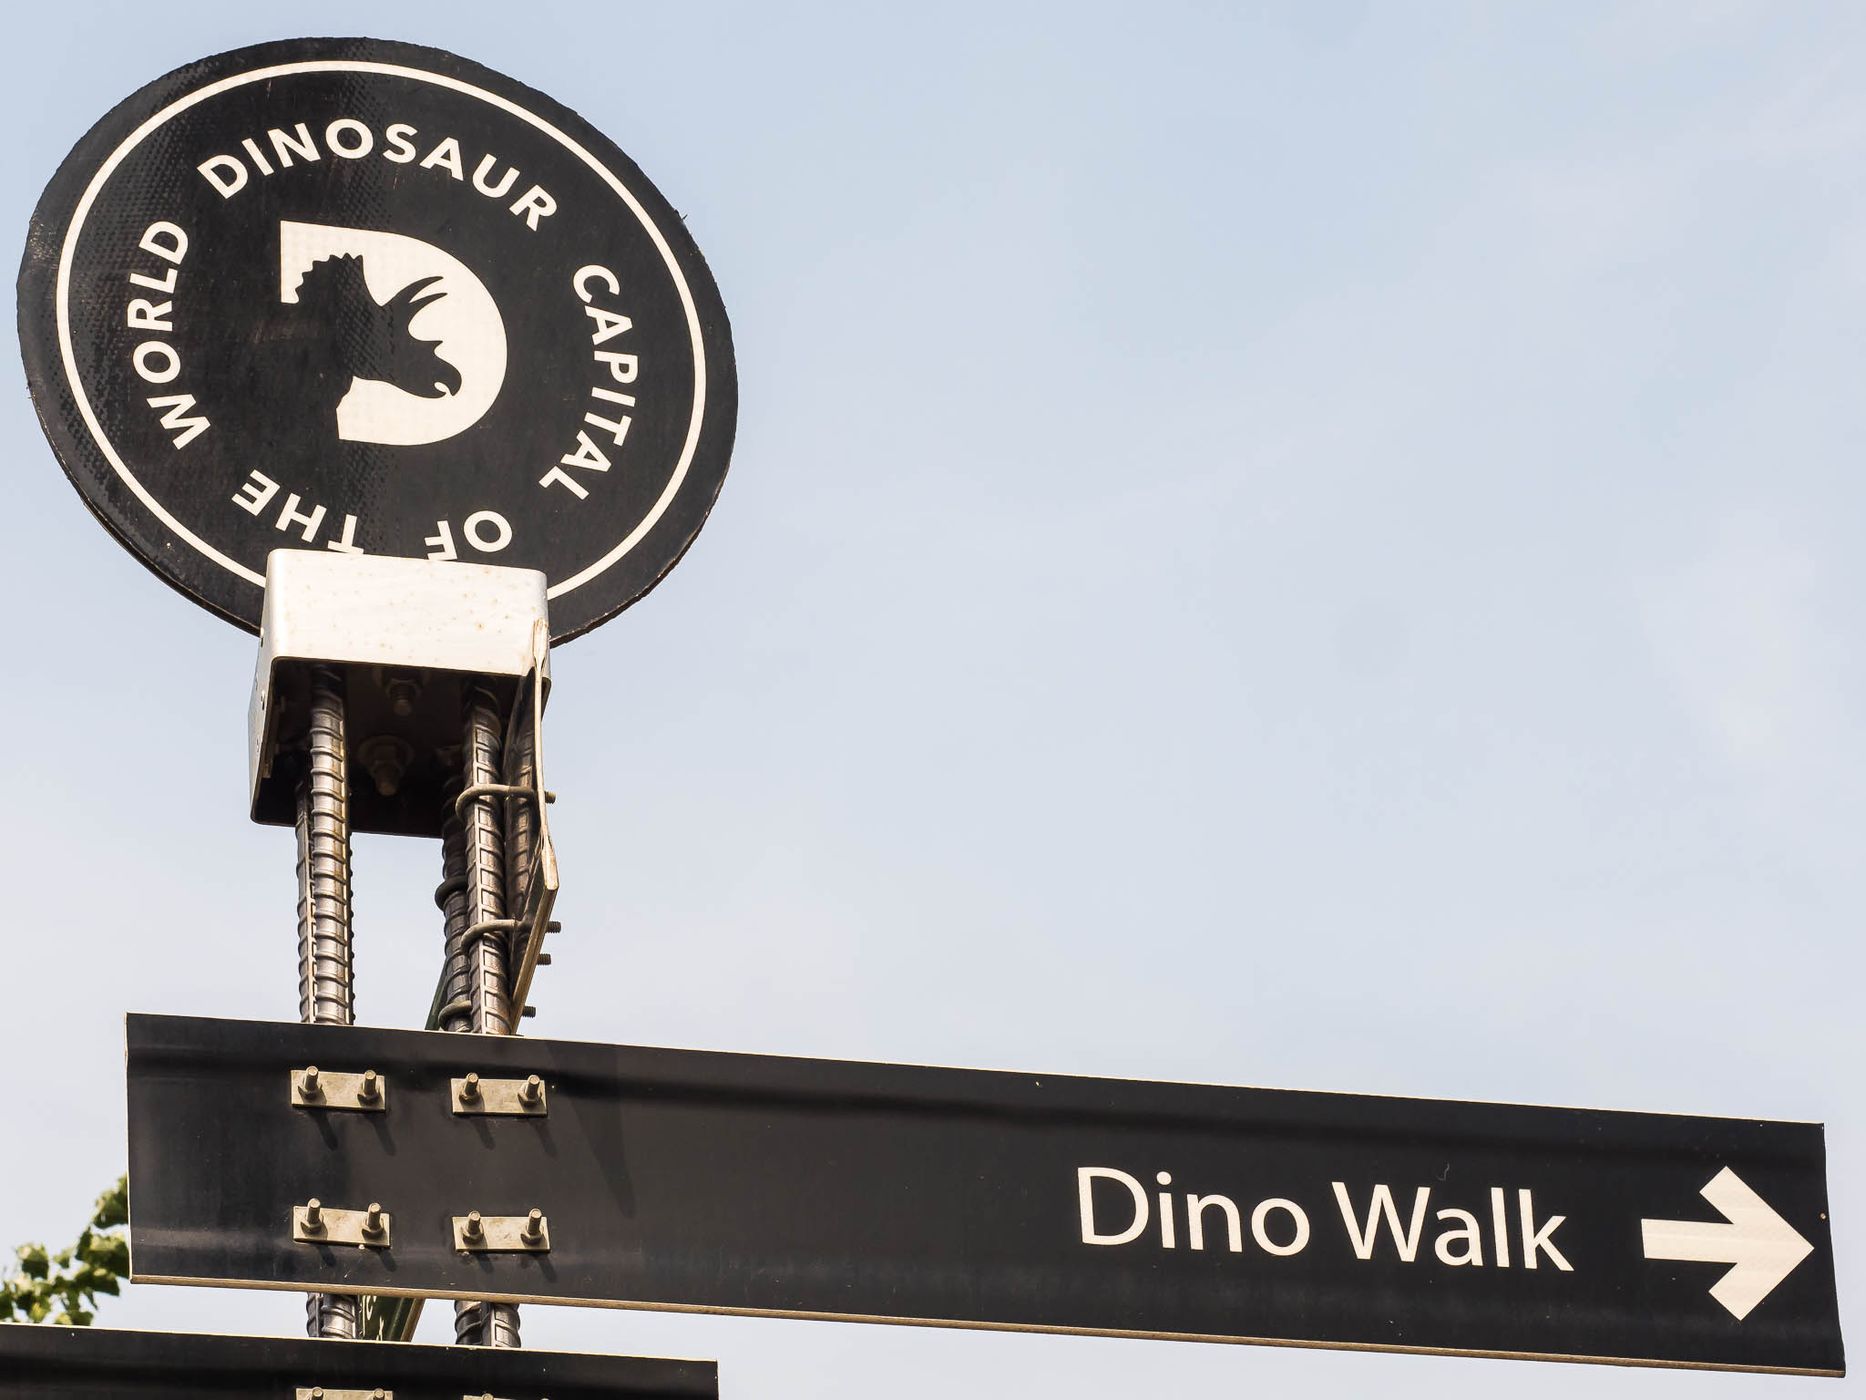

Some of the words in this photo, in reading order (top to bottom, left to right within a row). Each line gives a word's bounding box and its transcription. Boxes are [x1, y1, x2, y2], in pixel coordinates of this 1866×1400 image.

[196, 118, 558, 232] DINOSAUR
[126, 221, 211, 450] WORLD
[538, 264, 639, 500] CAPITAL
[231, 469, 365, 555] THE
[424, 510, 513, 561] OF
[1077, 1166, 1310, 1256] Dino
[1331, 1181, 1575, 1272] Walk
